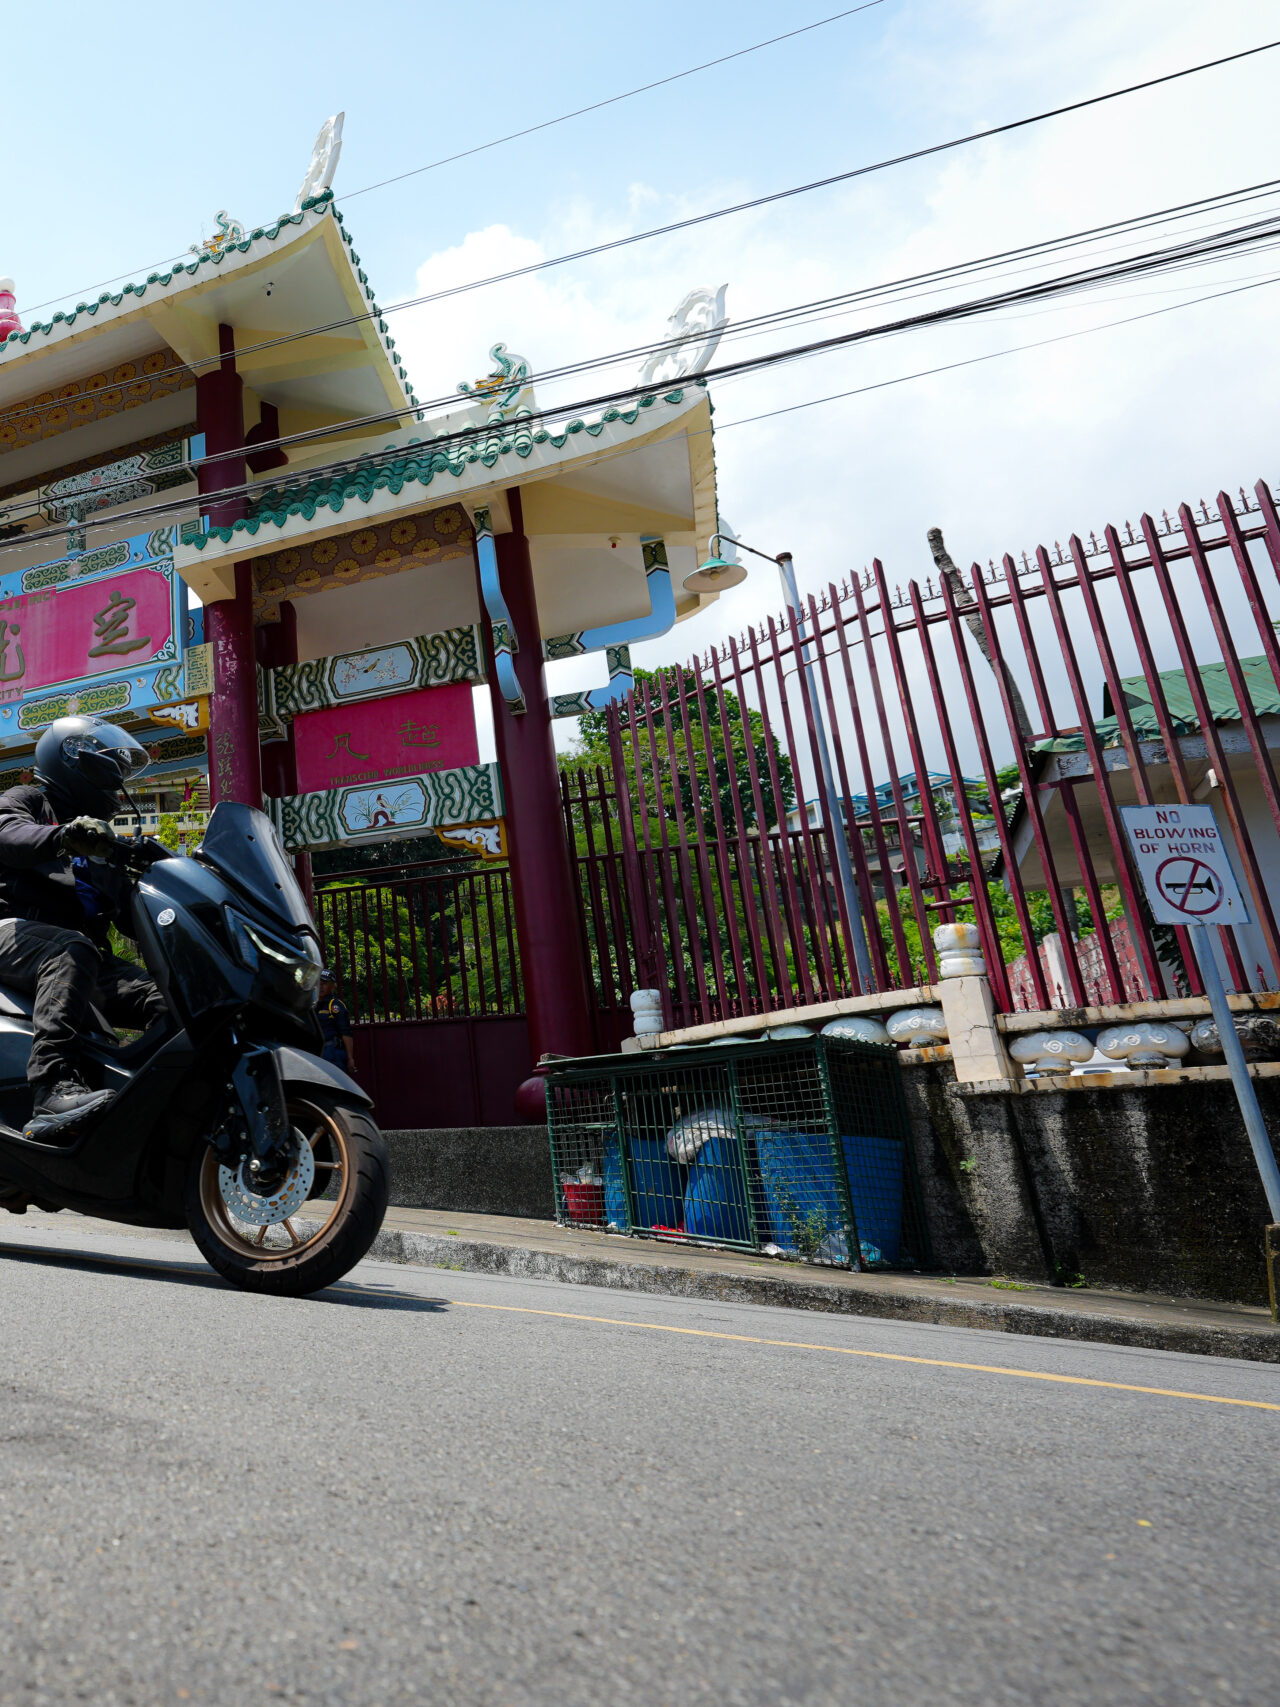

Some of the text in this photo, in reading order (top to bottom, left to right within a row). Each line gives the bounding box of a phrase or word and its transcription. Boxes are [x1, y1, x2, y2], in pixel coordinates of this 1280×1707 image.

[1156, 811, 1181, 824] NO
[1133, 827, 1217, 839] BLOWING
[1140, 843, 1216, 854] OF HORN
